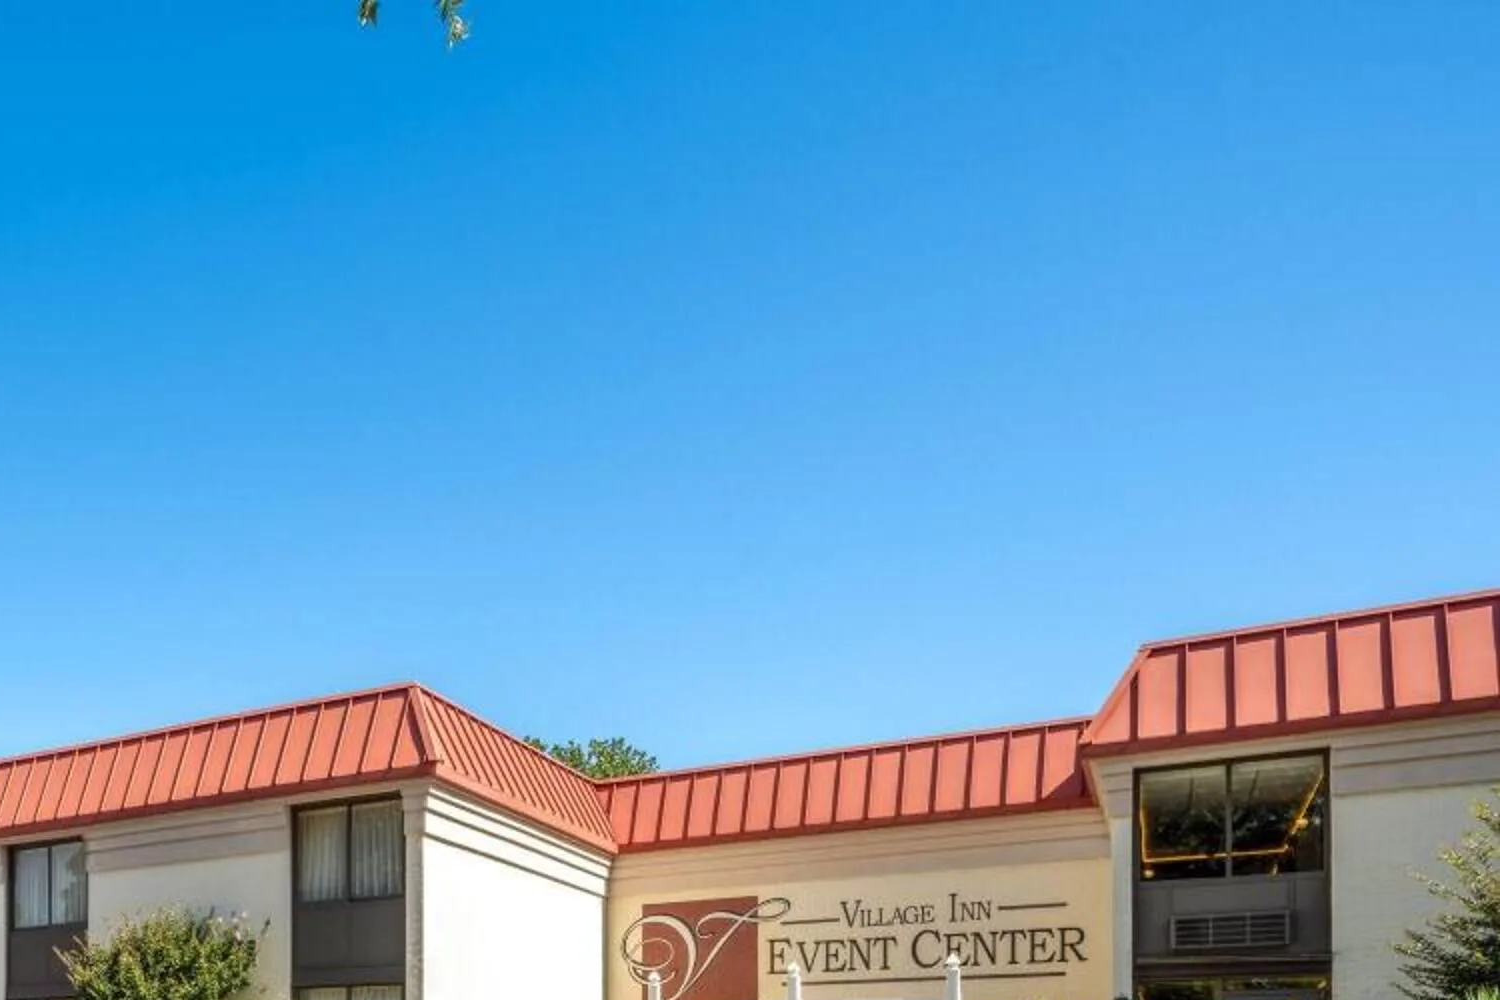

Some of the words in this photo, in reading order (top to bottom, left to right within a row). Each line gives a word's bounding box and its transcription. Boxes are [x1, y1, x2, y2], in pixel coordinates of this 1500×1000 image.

[840, 899, 935, 928] VILLAGE
[948, 893, 991, 923] INN
[766, 936, 899, 975] EVENT
[911, 926, 1088, 969] CENTER
